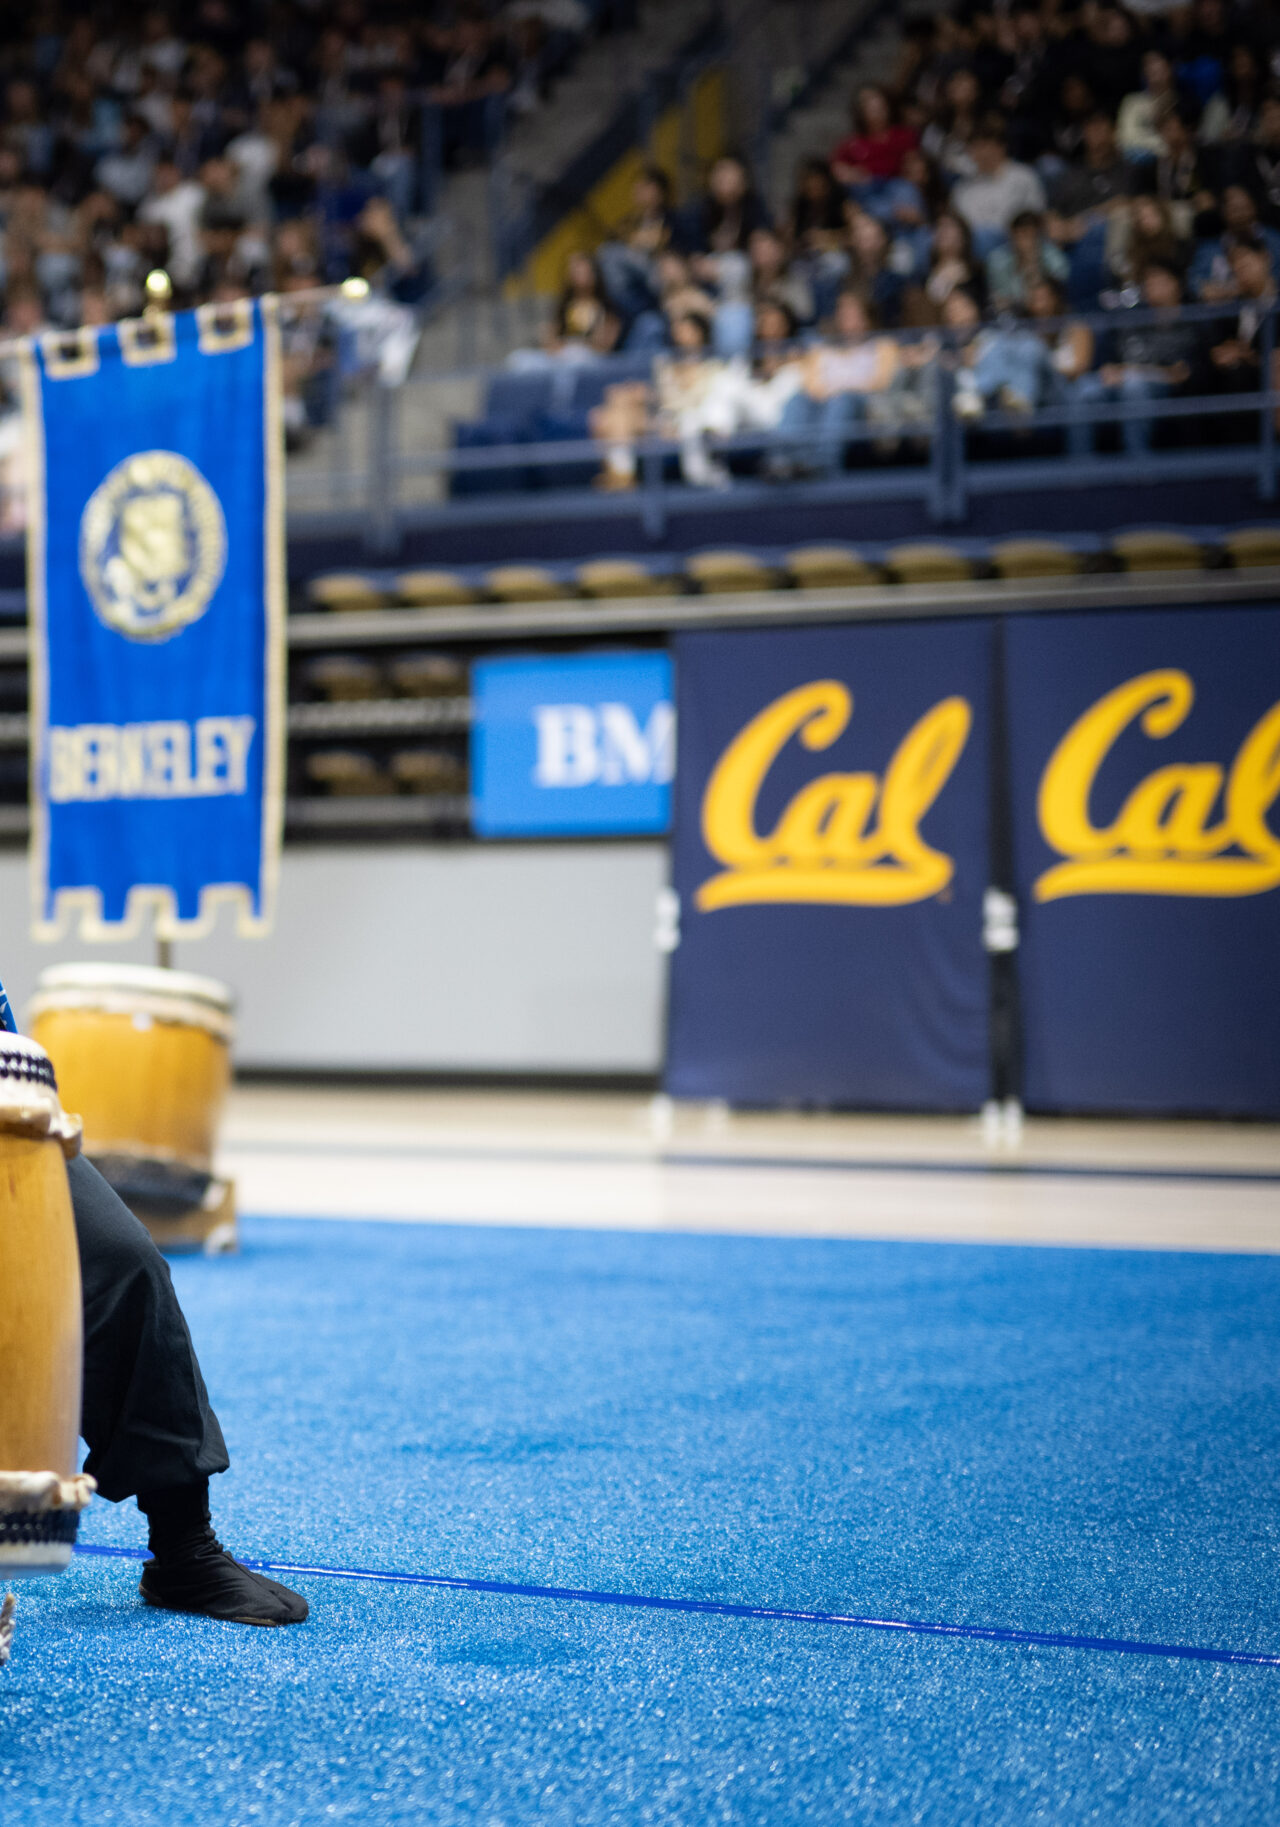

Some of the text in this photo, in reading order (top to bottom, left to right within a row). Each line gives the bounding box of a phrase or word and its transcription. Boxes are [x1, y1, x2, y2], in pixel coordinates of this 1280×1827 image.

[50, 715, 256, 803] BERKELEY
[696, 680, 971, 910] Cal
[1034, 667, 1280, 903] Cal
